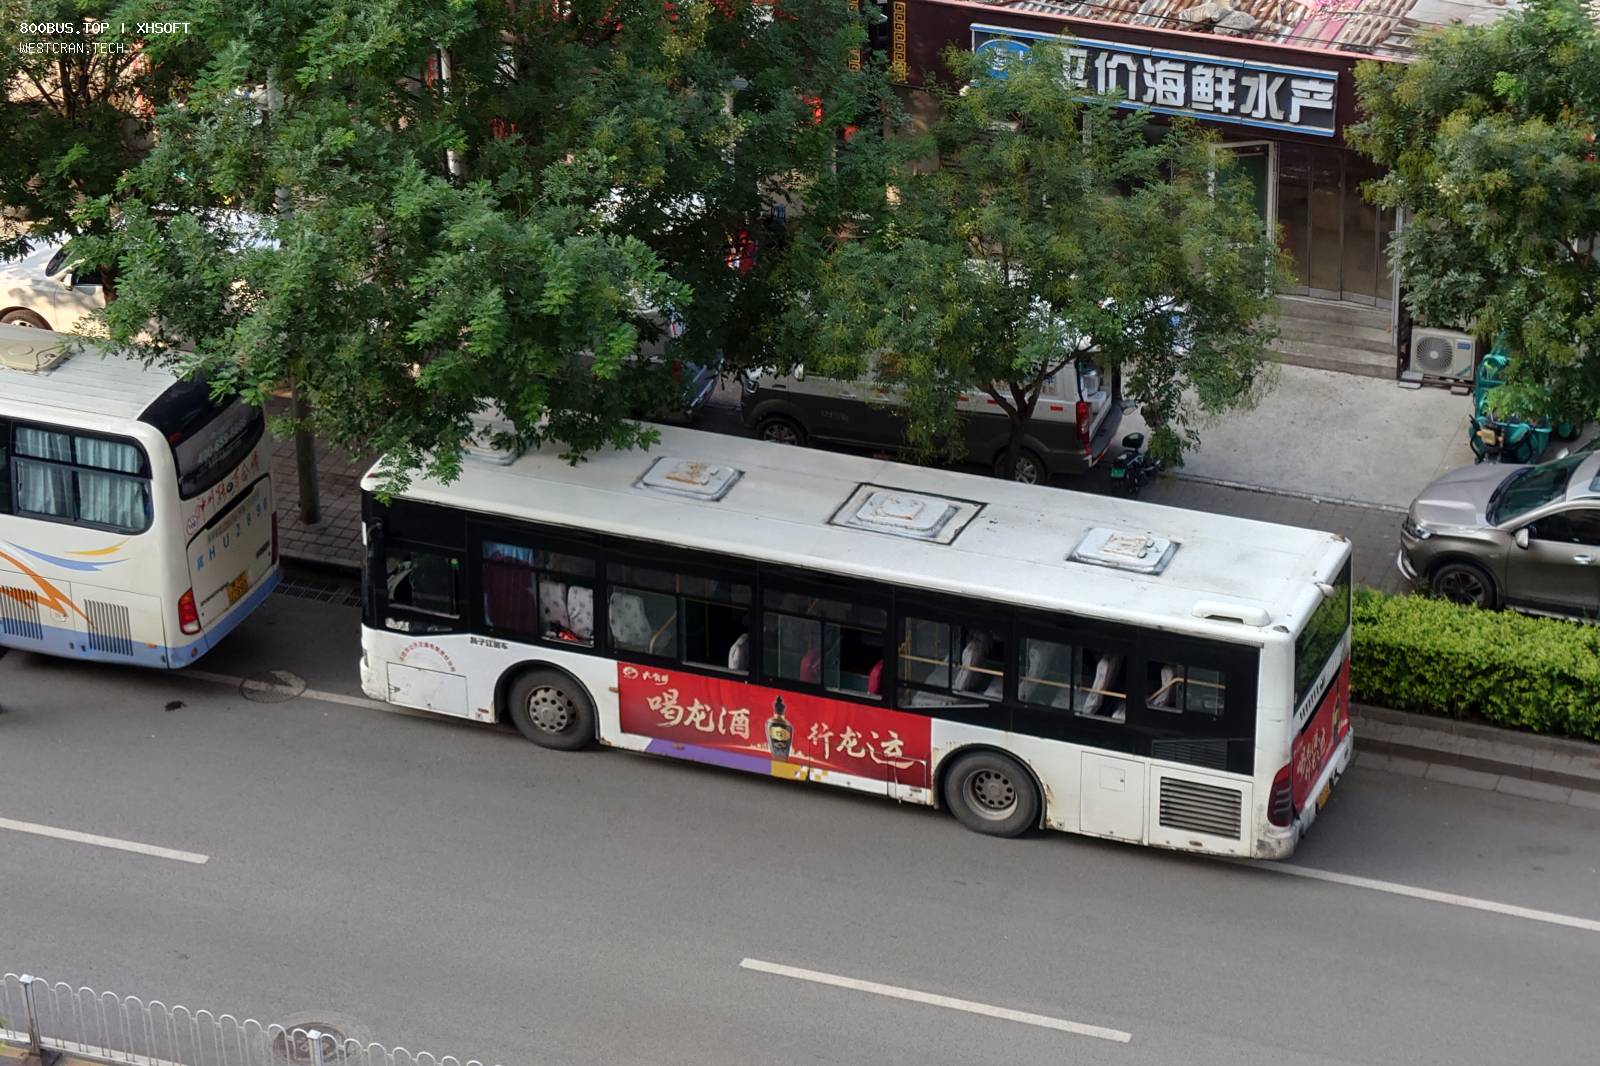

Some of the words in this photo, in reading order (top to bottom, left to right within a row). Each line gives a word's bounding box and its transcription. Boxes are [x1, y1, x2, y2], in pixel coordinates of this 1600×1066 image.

[647, 688, 751, 740] 喝龙酒
[807, 722, 914, 769] 行龙运
